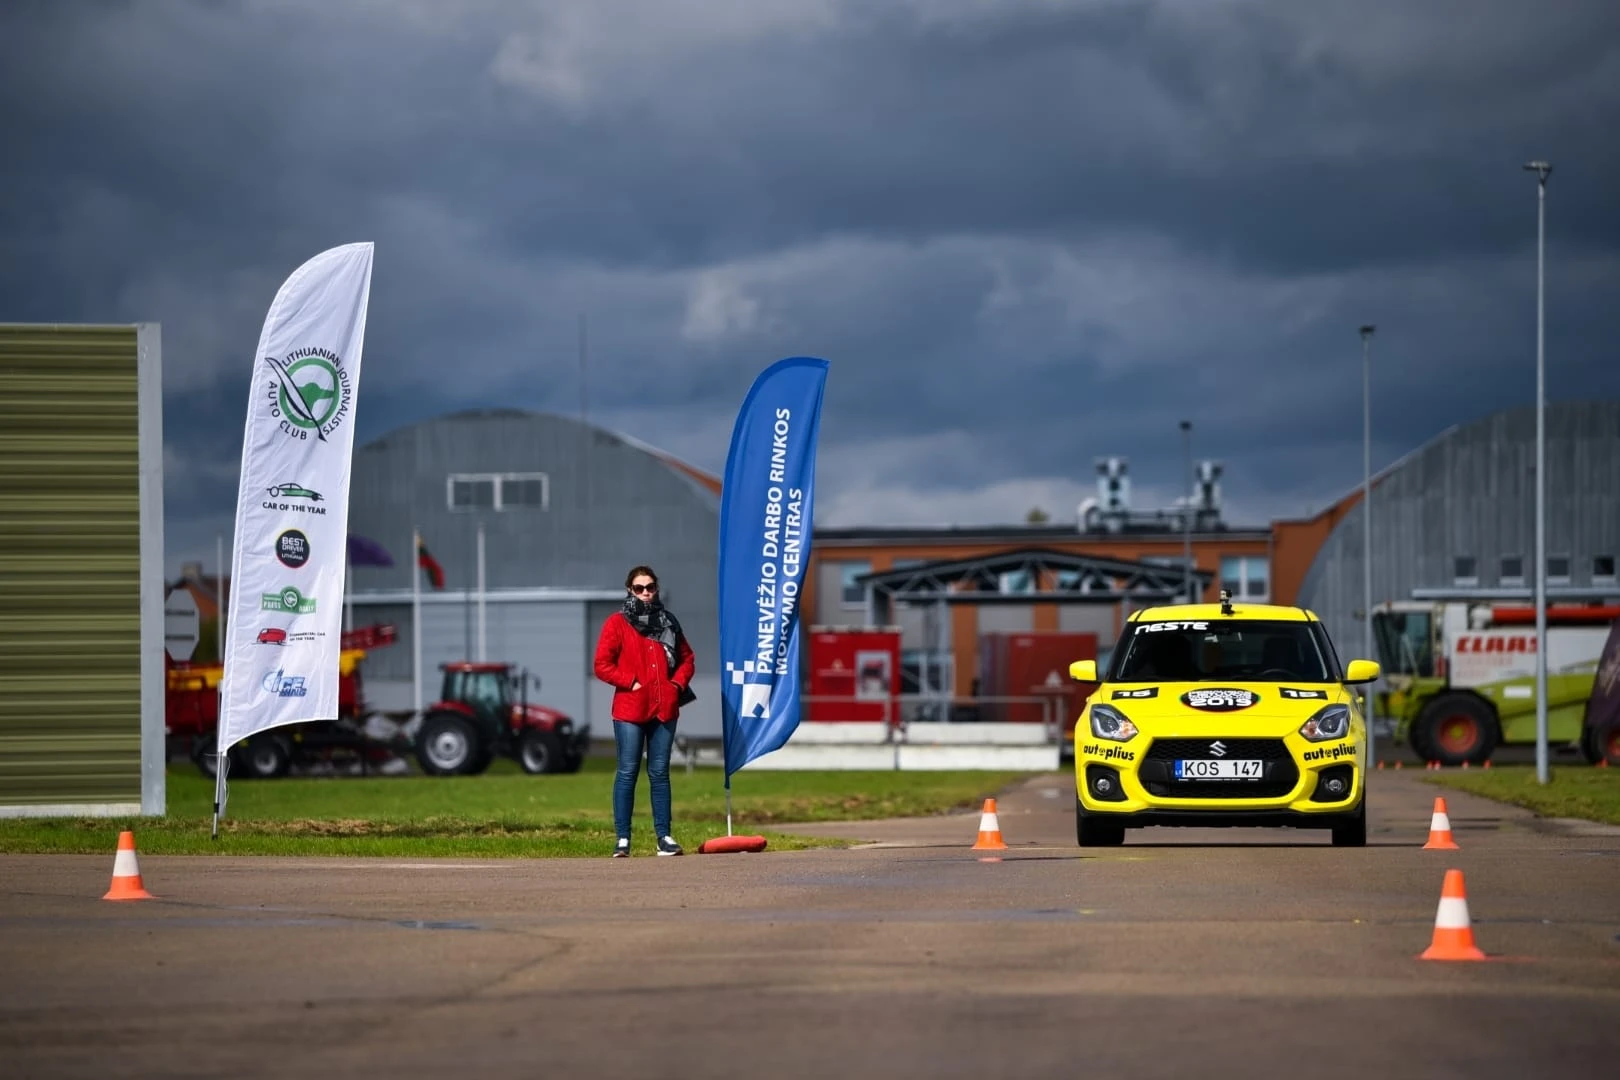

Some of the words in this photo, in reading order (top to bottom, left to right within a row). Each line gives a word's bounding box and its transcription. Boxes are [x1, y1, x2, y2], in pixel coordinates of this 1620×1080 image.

[268, 380, 281, 418] AUTO
[279, 420, 307, 440] CLUB
[281, 347, 341, 367] LITHUANIAN
[323, 367, 351, 436] JOURNALISTS
[769, 408, 790, 482] RINKOS
[262, 502, 277, 510] CAR
[279, 503, 289, 511] OF
[292, 504, 306, 512] THE
[307, 506, 326, 515] YEAR
[762, 487, 783, 558] DARBO
[783, 488, 802, 577] CENTRAS
[282, 536, 304, 547] BEST
[756, 562, 776, 674] PANEVĖŽIO
[1135, 622, 1209, 635] NESTE
[1184, 761, 1220, 776] KOS
[1233, 761, 1261, 776] 147
